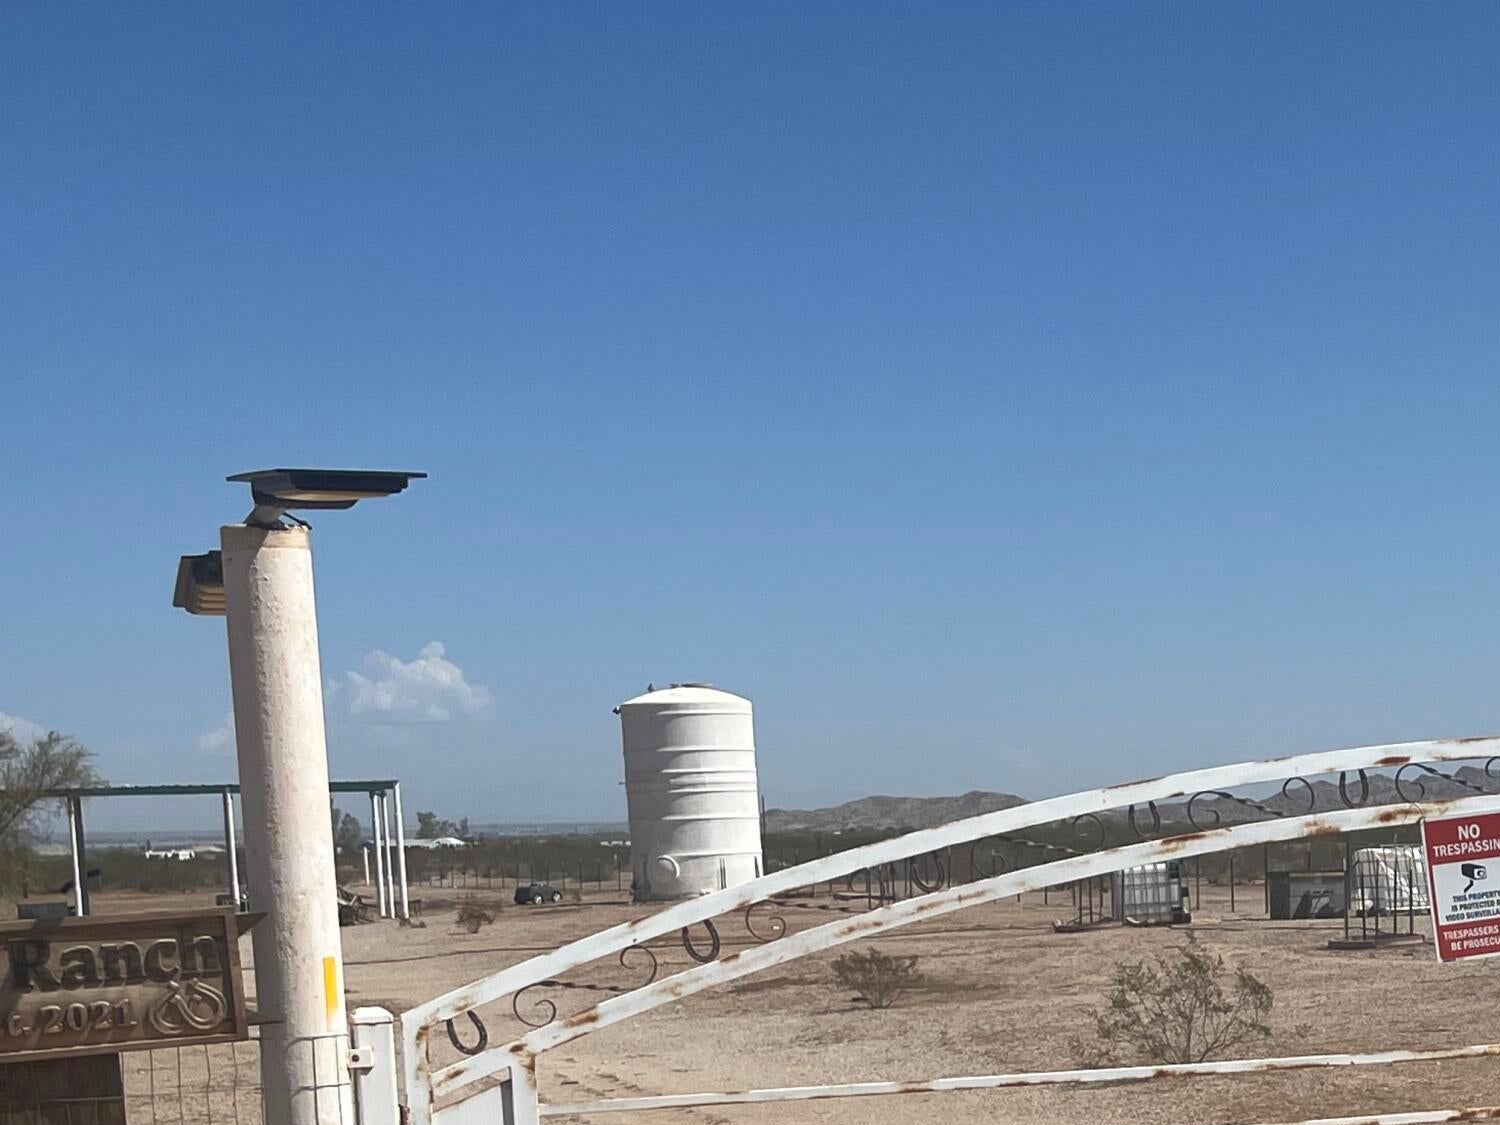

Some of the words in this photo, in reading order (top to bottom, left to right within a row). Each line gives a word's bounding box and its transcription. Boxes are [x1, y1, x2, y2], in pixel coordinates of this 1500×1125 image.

[1457, 824, 1481, 841] NO
[1452, 892, 1468, 903] THIS
[1468, 889, 1500, 901] PROPERTY
[1451, 904, 1459, 913] IS
[1459, 900, 1496, 912] PROTECTED
[1445, 912, 1465, 922] VIDEO
[1443, 924, 1500, 941] TRESPASSERS
[1450, 940, 1463, 951] BE
[8, 924, 223, 993] Ranch
[38, 998, 139, 1034] 2021
